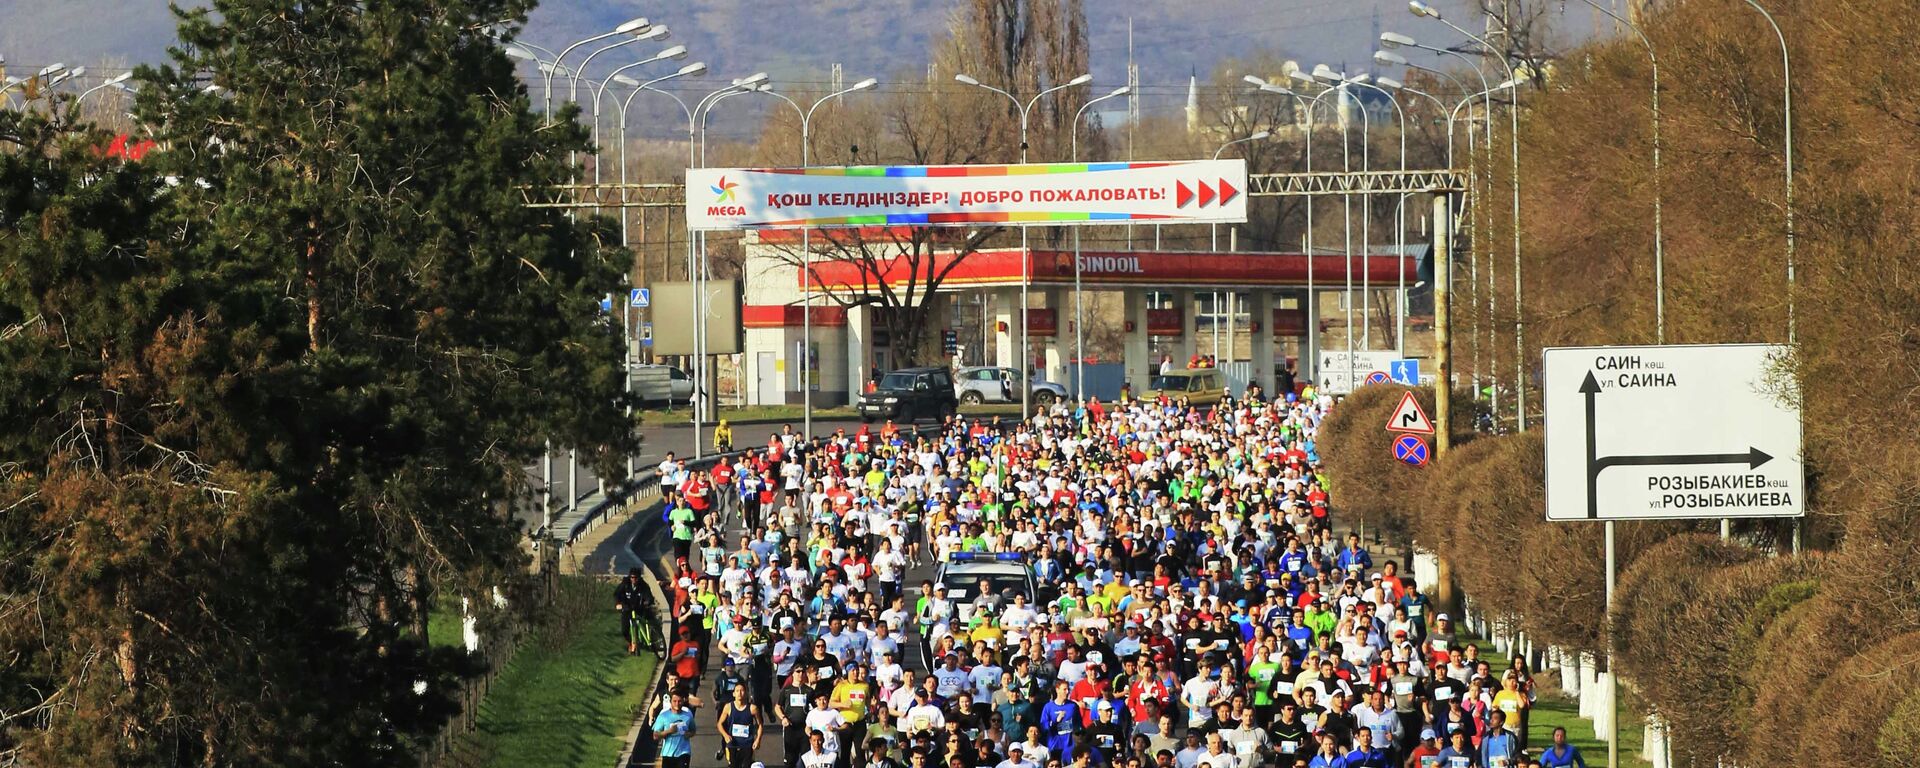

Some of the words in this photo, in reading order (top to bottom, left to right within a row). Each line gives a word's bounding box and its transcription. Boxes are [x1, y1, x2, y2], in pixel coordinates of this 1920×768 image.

[768, 193, 812, 208] ҚОШ
[818, 191, 949, 208] КЕЛДІҢІЗДЕР!
[960, 190, 1023, 206] ДОБРО
[1030, 187, 1165, 202] ПОЖАЛОВАТЬ!
[707, 206, 746, 216] MEGA
[1078, 256, 1144, 273] SINOOIL
[1337, 353, 1359, 361] САН
[1595, 356, 1641, 370] САИН
[1618, 372, 1677, 388] САИНА
[1648, 475, 1766, 490] РОЗЫБАКИЕВ
[1663, 492, 1793, 508] РОЗЫБАКИЕВА
